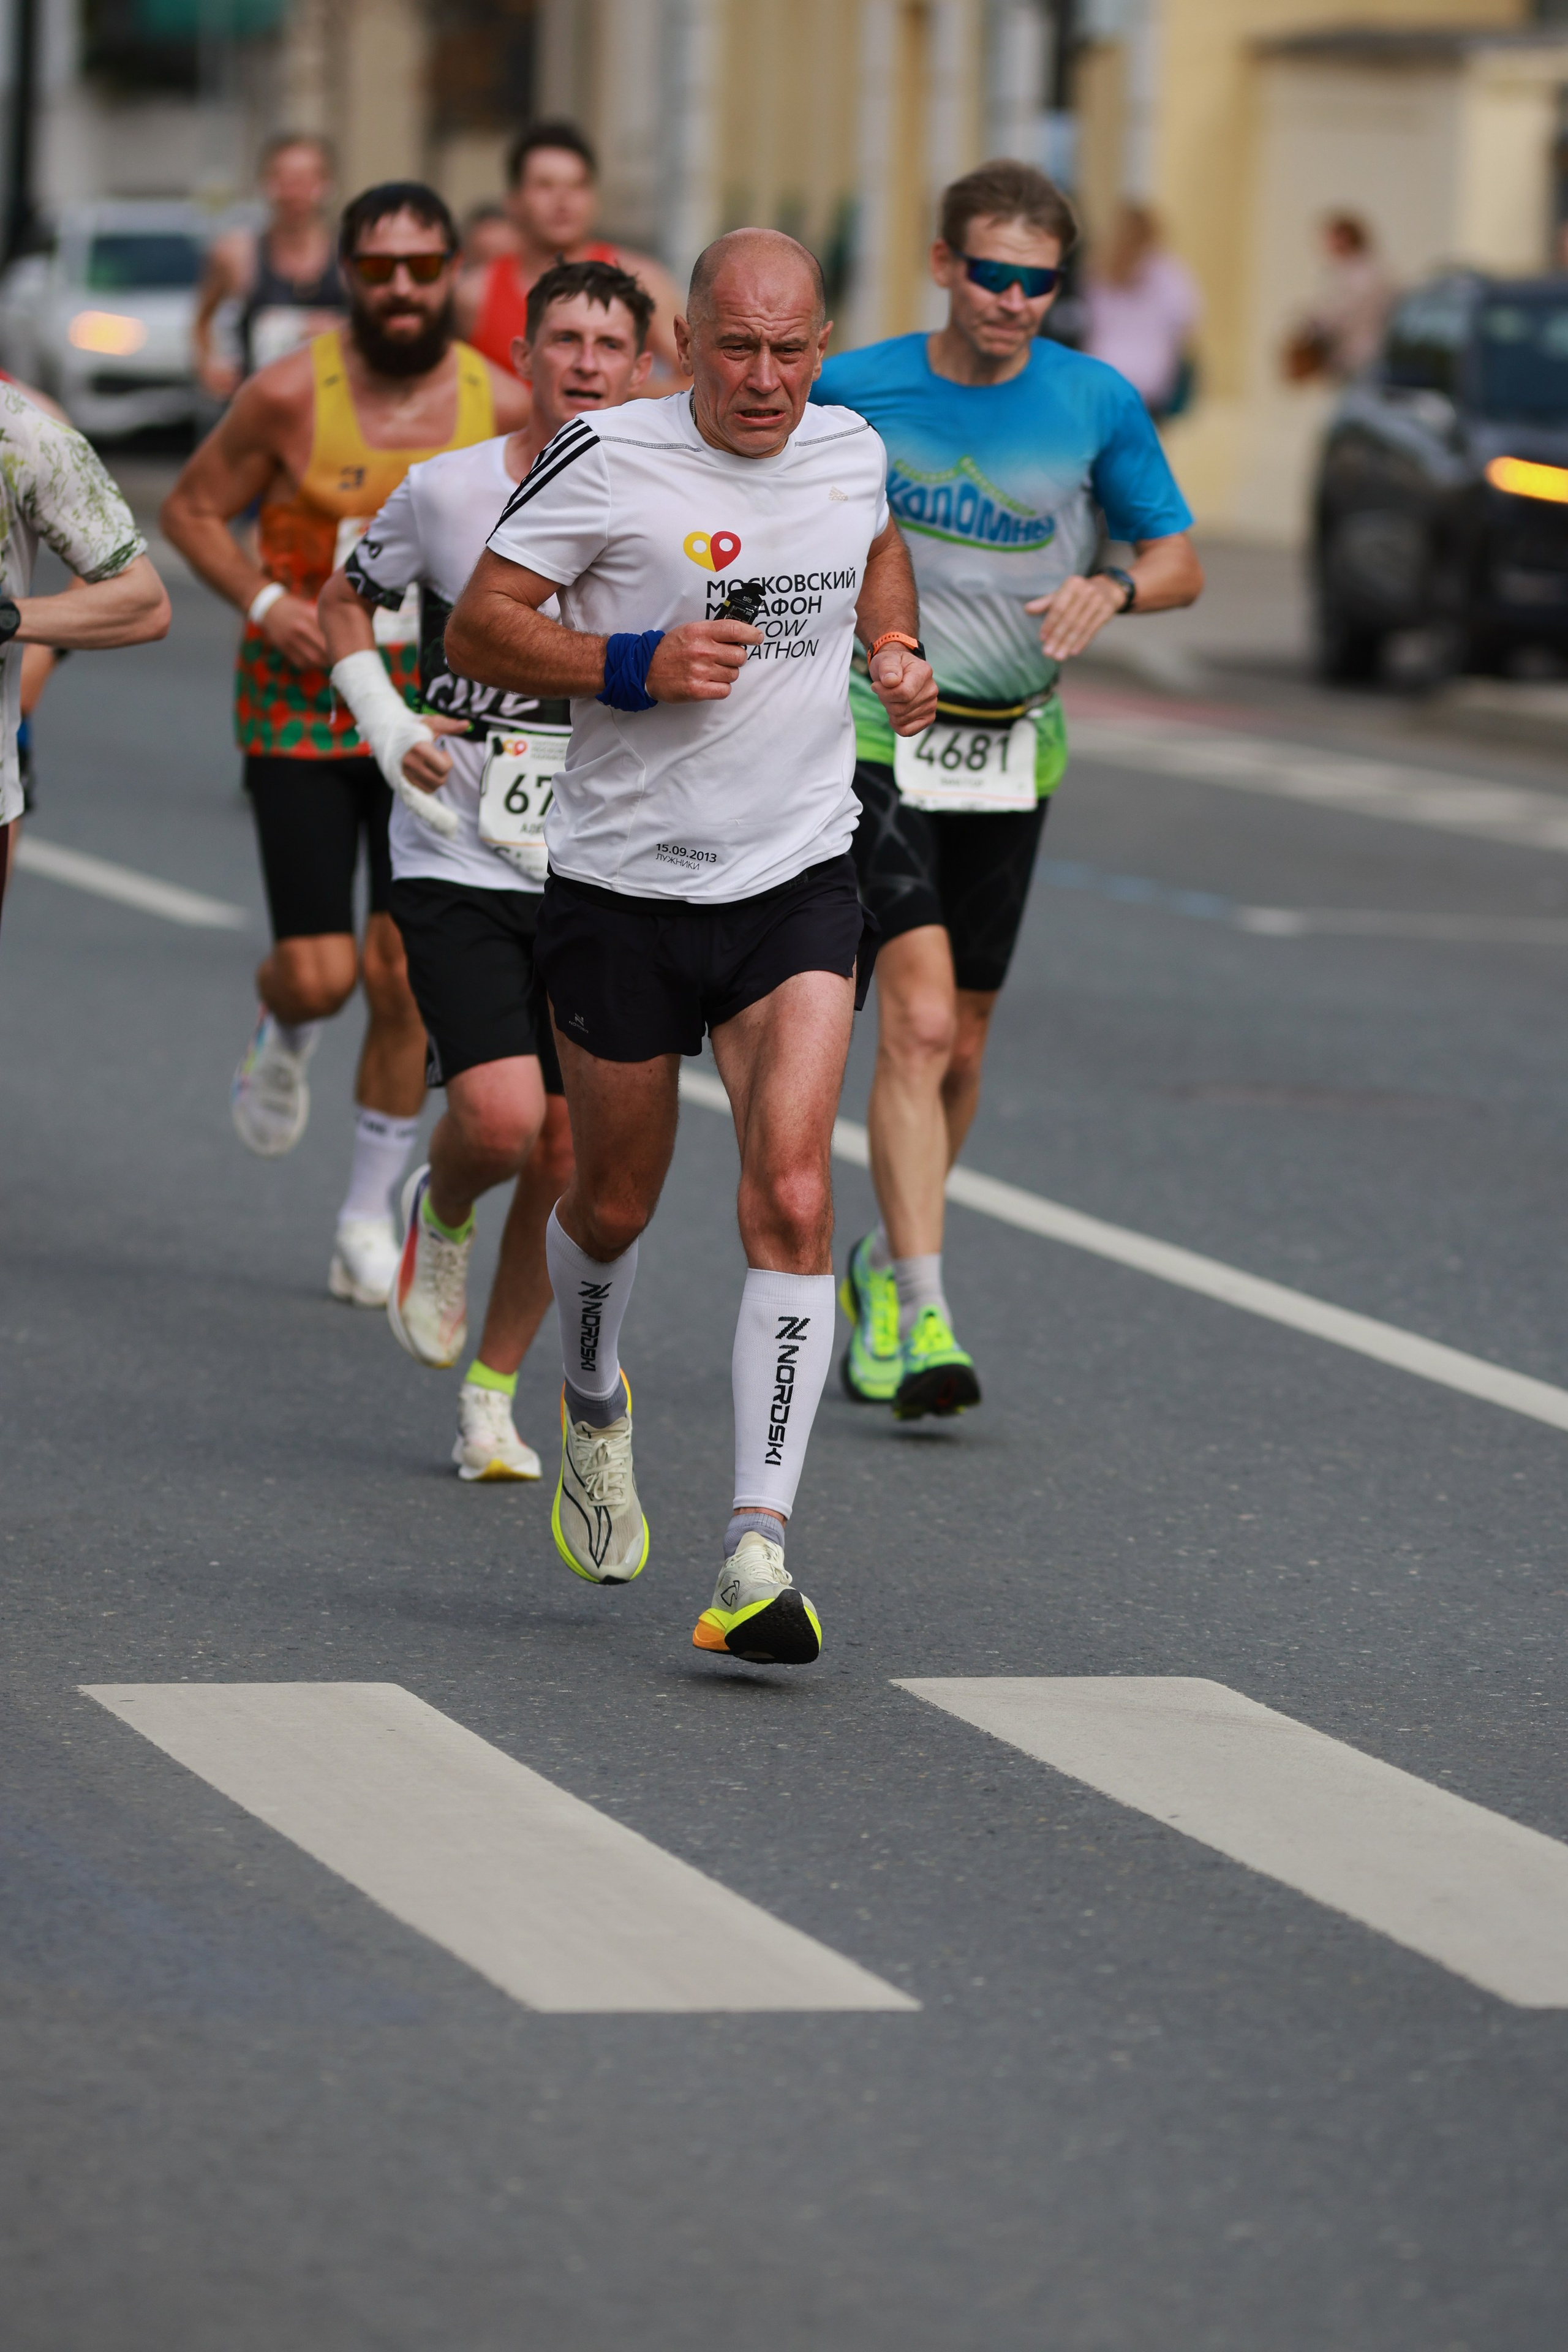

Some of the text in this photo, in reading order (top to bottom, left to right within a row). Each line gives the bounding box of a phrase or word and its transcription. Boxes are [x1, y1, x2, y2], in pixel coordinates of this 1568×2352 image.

[706, 567, 856, 598] МОКОВСКИЙ
[705, 595, 822, 620] МАФОН
[915, 727, 1009, 772] 4681
[504, 774, 553, 816] 67
[655, 853, 700, 870] ЛУЖНИКИ
[656, 843, 717, 862] 15.09.2013
[580, 1300, 603, 1371] NORDSKI
[765, 1345, 799, 1466] NORDSKI
